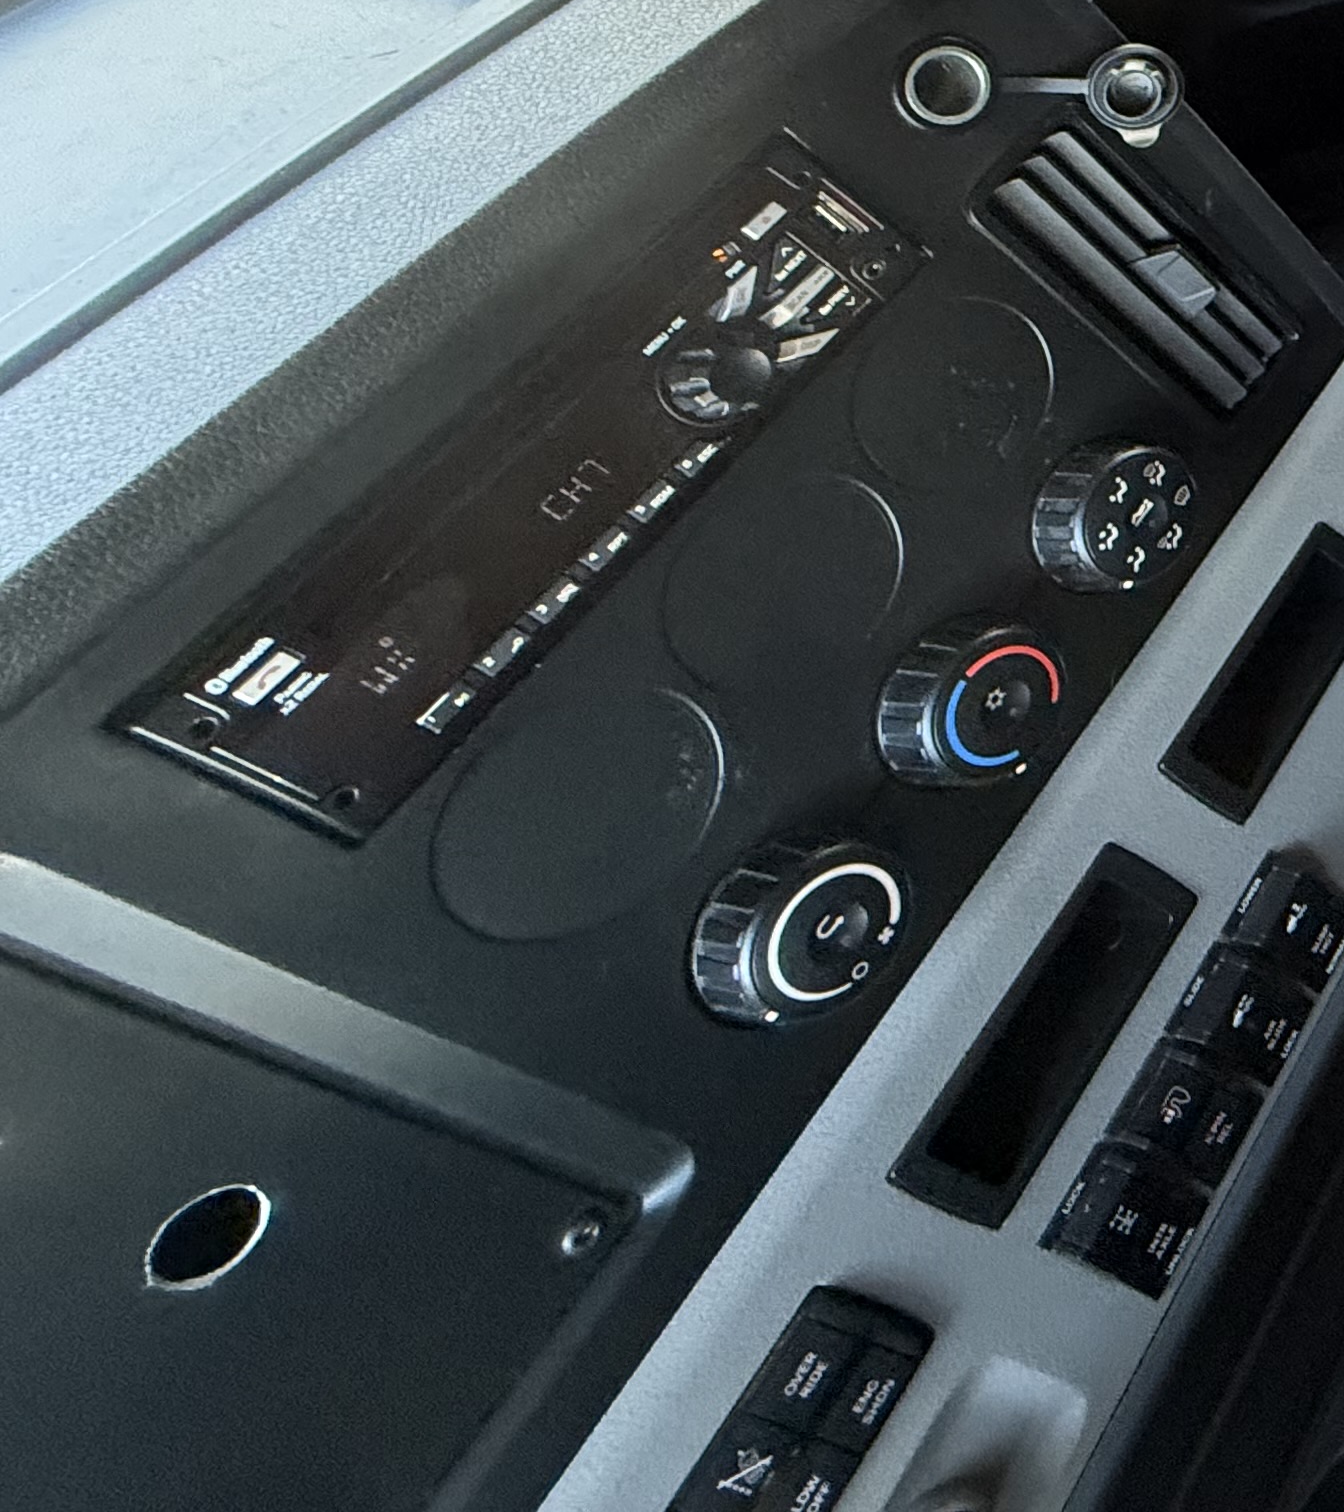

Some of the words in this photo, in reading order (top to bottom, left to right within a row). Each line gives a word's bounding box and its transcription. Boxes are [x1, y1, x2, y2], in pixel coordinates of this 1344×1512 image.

[785, 249, 807, 272] NEXT
[642, 331, 670, 357] MENU
[1237, 877, 1263, 914] LOWER
[1183, 976, 1205, 1008] SLIDE
[1061, 1181, 1086, 1215] LOCK
[1156, 1226, 1178, 1260] AXLE
[1165, 1227, 1195, 1275] UNLOCK
[784, 1351, 819, 1397] OVER
[799, 1361, 829, 1399] RIDE
[852, 1379, 880, 1414] ENG
[861, 1378, 896, 1426] SHDN
[806, 1481, 831, 1512] OFF
